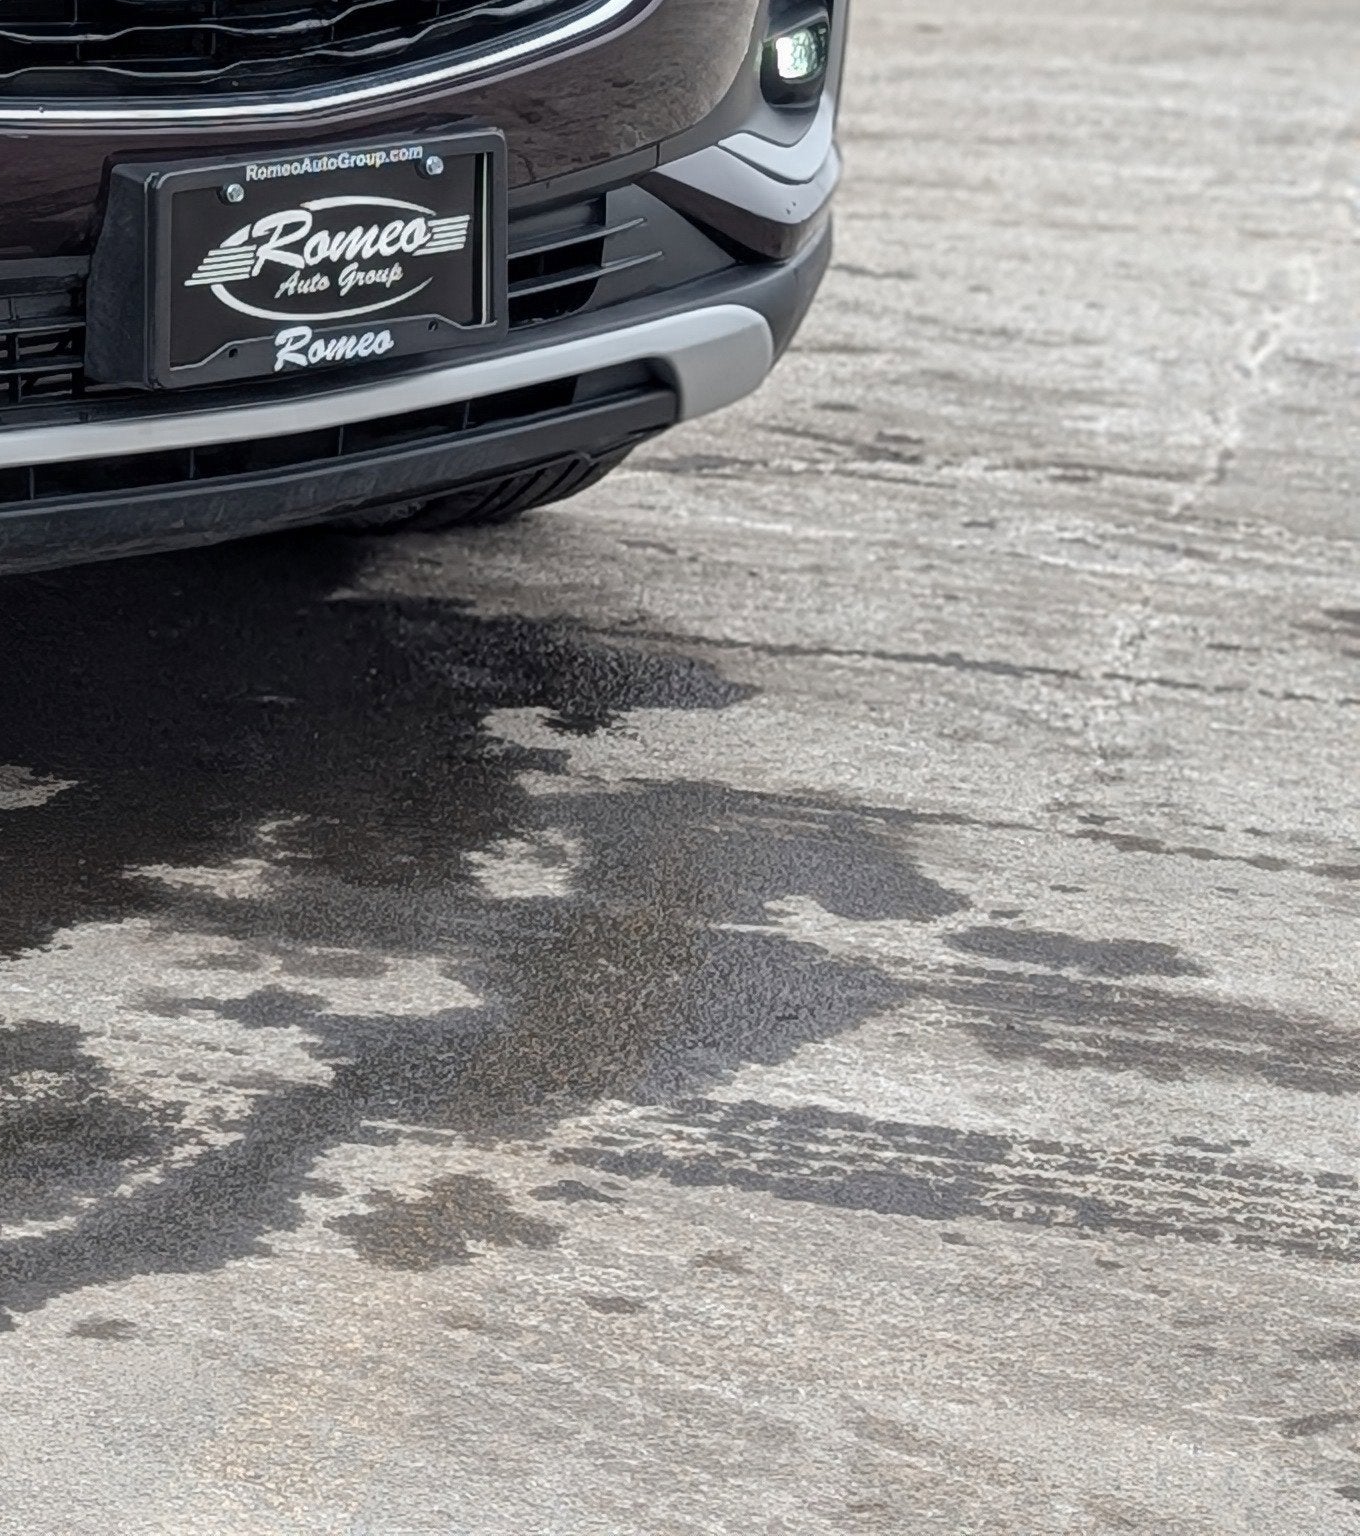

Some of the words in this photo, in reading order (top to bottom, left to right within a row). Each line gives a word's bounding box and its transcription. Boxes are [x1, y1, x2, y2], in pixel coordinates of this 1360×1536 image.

[245, 146, 423, 181] RomeoAutoGroup.com
[251, 209, 431, 277] Romeo
[274, 270, 330, 299] Auto
[338, 262, 403, 297] Group
[273, 325, 395, 372] Romeo
